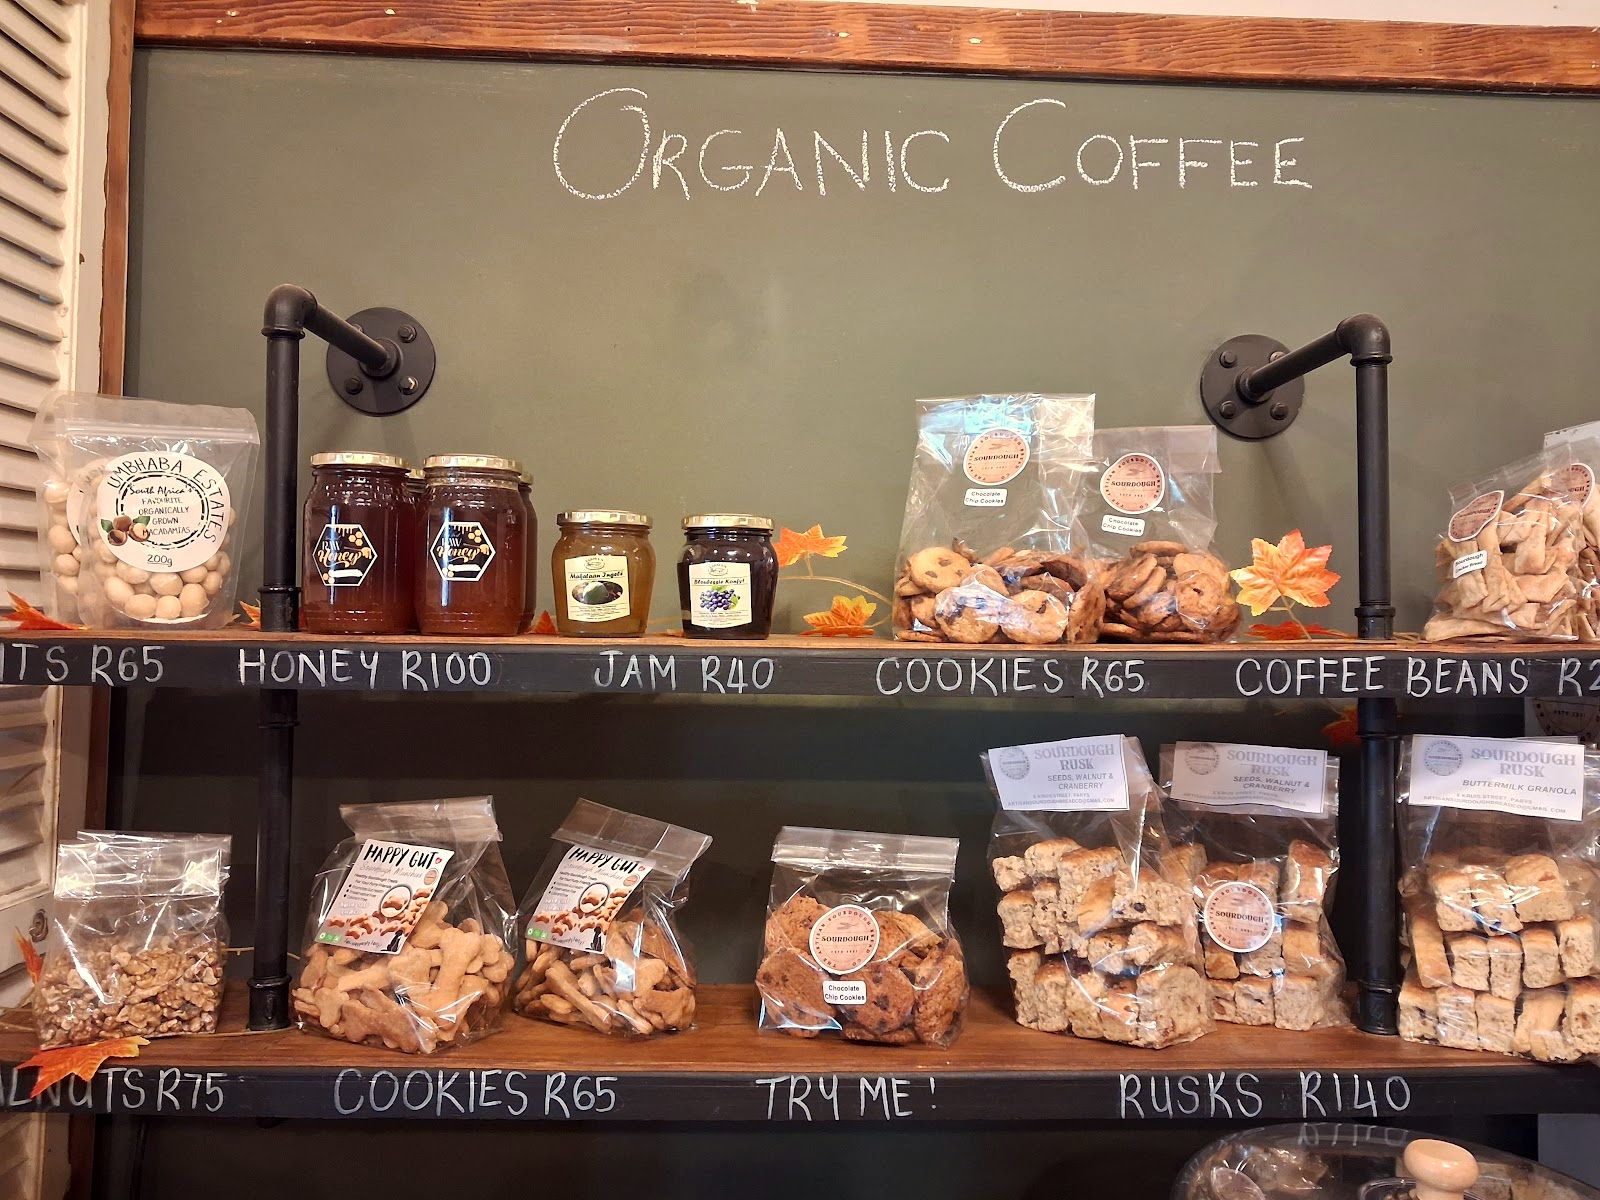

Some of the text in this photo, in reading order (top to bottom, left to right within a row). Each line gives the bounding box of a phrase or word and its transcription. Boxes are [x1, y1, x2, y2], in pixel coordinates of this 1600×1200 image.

[973, 453, 1019, 462] SOURDOUGH
[129, 486, 155, 496] South
[1110, 480, 1157, 488] SOURDOUGH
[107, 456, 183, 489] UMBHABA
[193, 468, 225, 543] ESTATES
[138, 506, 190, 516] ORGANICALLY
[152, 517, 179, 526] GROWN
[142, 526, 191, 536] MACADAMIAS
[147, 553, 173, 567] 200g
[317, 549, 362, 568] Honey
[91, 643, 166, 687] R65
[237, 647, 492, 692] HONEY R100
[593, 649, 775, 694] JAM R40
[875, 655, 1146, 699] COOKIES R65
[1235, 655, 1386, 697] COFFEE
[1407, 656, 1530, 698] BEANS
[1034, 743, 1115, 760] SOURDOUGH
[1226, 749, 1318, 767] SOURDOUGH
[1470, 747, 1577, 767] SOURDOUGH
[1059, 758, 1095, 771] RUSK
[1250, 765, 1291, 777] RUSK
[1500, 762, 1545, 778] RUSK
[1047, 772, 1114, 782] SEEDS, WALNUT &
[1233, 775, 1263, 783] SEEDS,
[1265, 777, 1303, 788] WALNUT
[1058, 781, 1104, 790] CRANBERRY
[1242, 782, 1297, 794] CRANBERRY
[1461, 779, 1577, 796] BUTTERMILK GRANOLA
[363, 843, 439, 870] HAPPY GUT
[568, 847, 614, 869] HAPPY
[610, 857, 641, 874] GUT
[1215, 909, 1264, 923] SOURDOUGH
[821, 934, 869, 943] SOURDOUGH
[828, 983, 860, 992] Chocolate
[824, 993, 865, 1001] Chip Cookies
[0, 1067, 227, 1112] LNUTS R75
[333, 1067, 619, 1119] COOKIES R65
[756, 1074, 841, 1121] TRY
[1120, 1072, 1412, 1119] RUSKS R140
